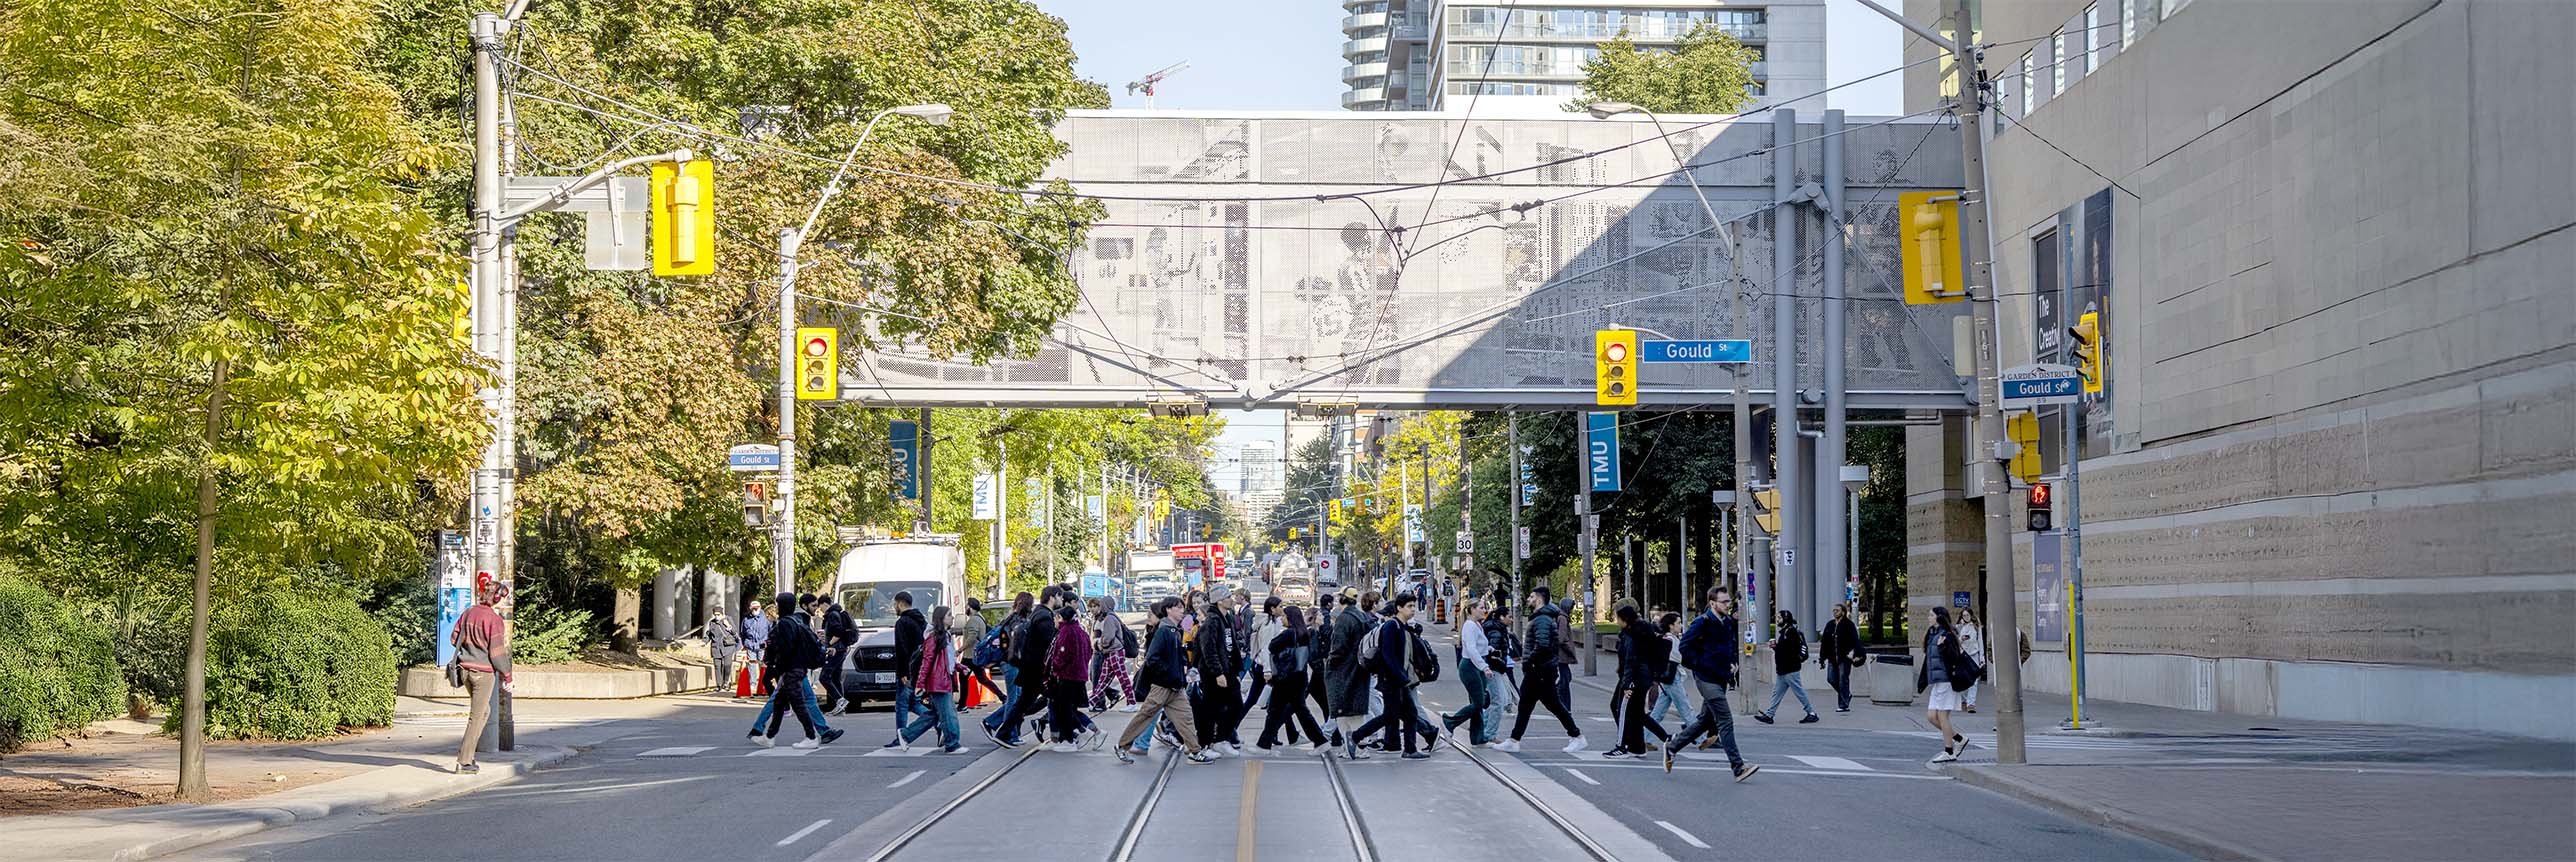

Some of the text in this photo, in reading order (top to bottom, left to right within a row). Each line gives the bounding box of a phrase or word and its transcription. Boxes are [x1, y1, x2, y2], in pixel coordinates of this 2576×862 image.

[2038, 295, 2050, 319] The
[1666, 343, 1729, 359] Gould St
[2007, 370, 2070, 381] GARDEN DISTRICT
[2020, 382, 2051, 395] Gould
[740, 455, 762, 464] Gould
[1591, 441, 1610, 488] TMU
[975, 480, 988, 516] TMU
[1458, 539, 1472, 550] 30
